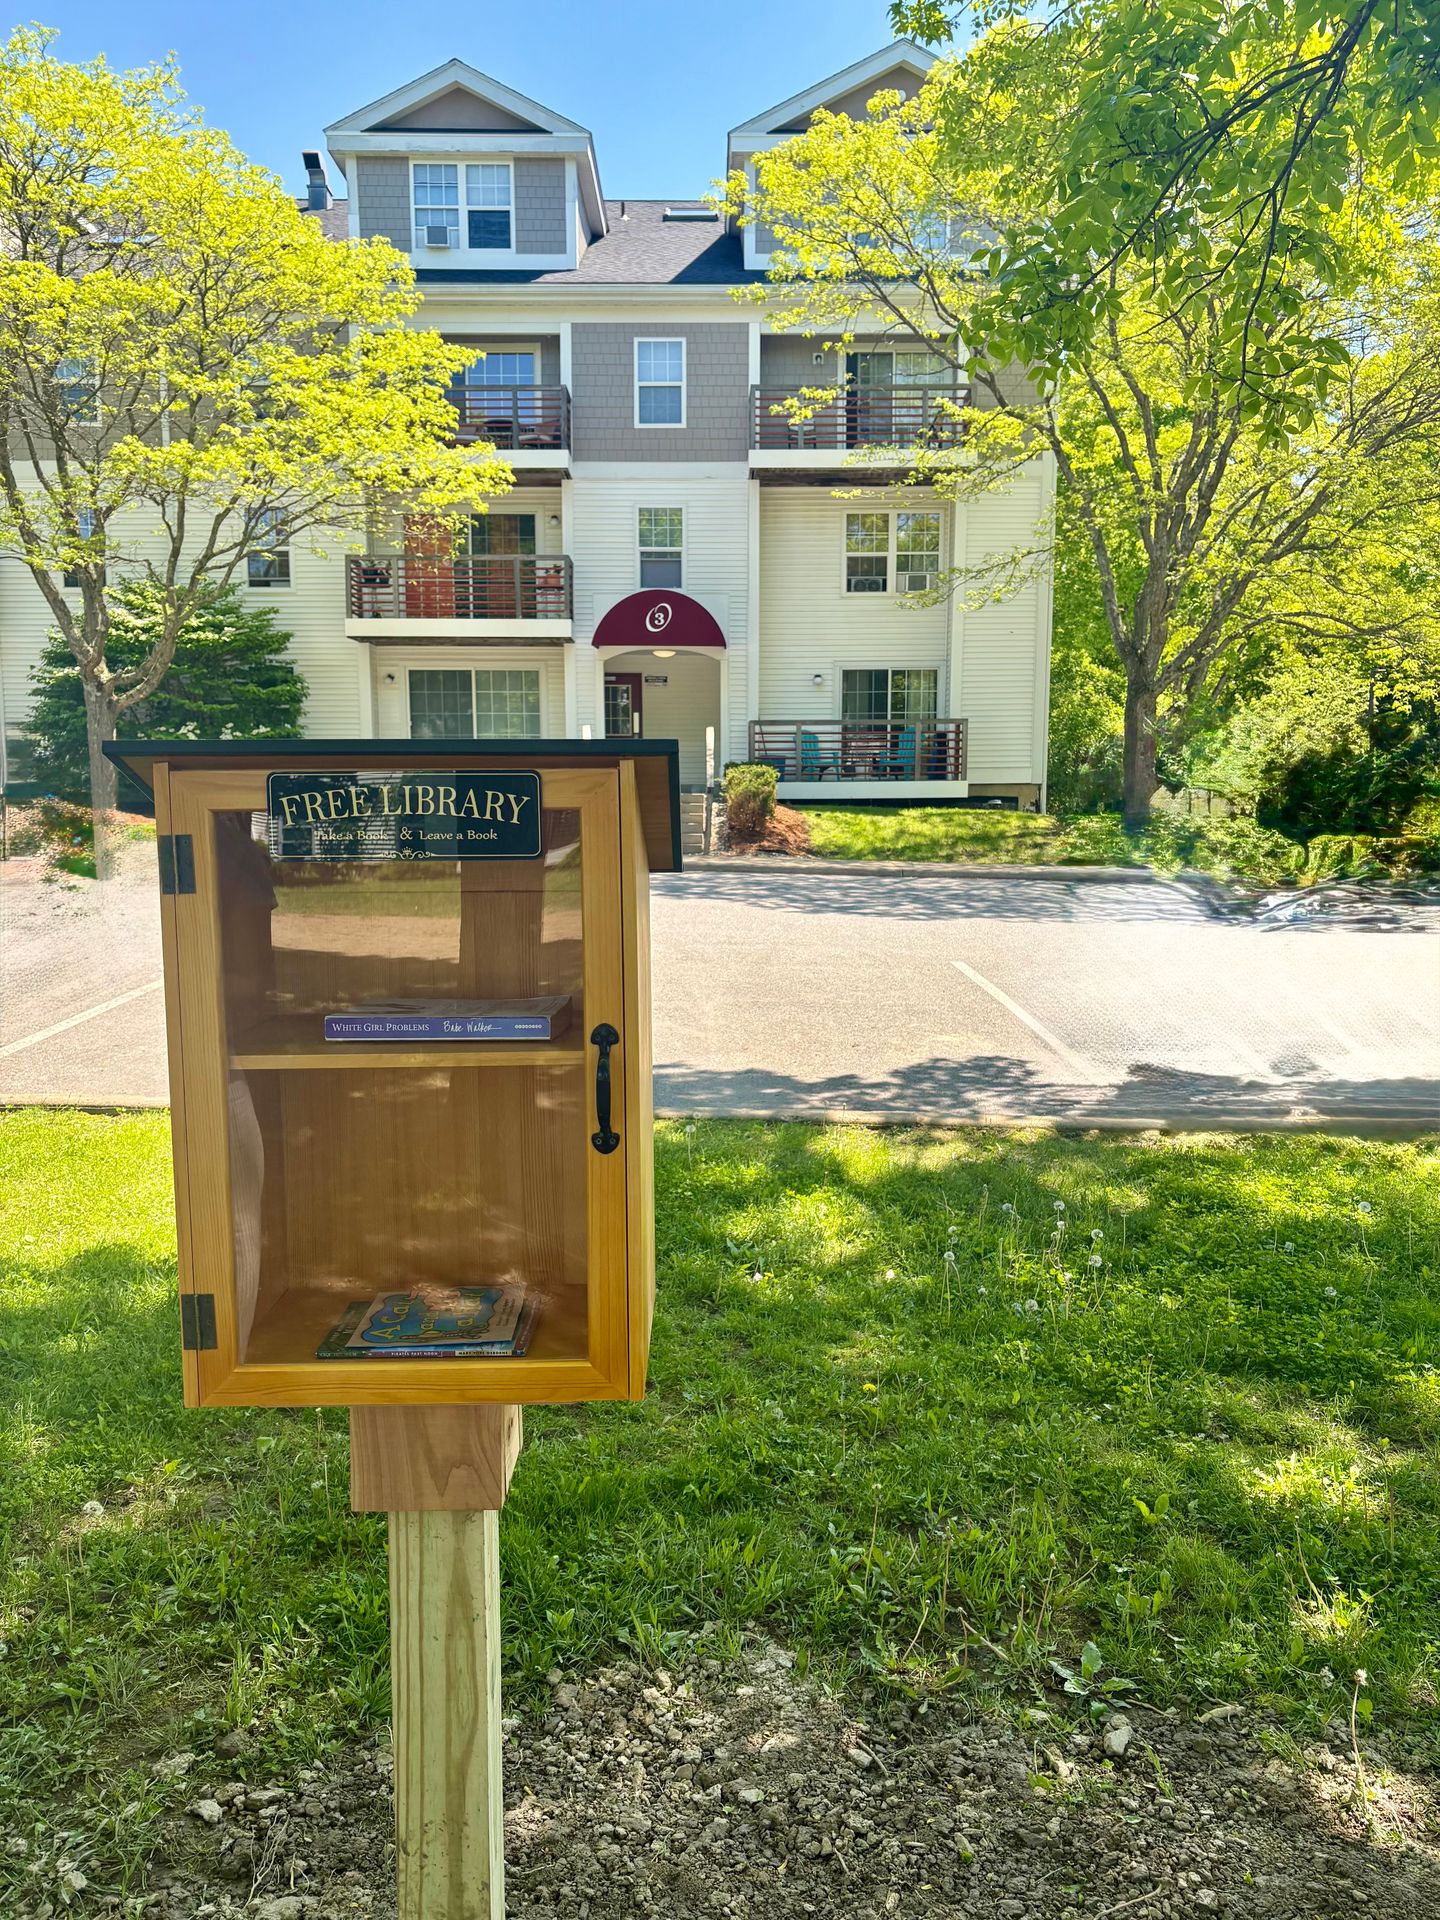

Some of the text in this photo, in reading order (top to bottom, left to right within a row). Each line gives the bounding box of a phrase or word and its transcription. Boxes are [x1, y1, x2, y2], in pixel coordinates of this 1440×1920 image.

[654, 612, 665, 626] 3
[279, 785, 532, 827] FREE LIBRARY
[314, 826, 499, 841] Take a Book & Leave a Book
[332, 1022, 430, 1032] WHITE GIRL PROBLEMS
[443, 1020, 464, 1033] Babe
